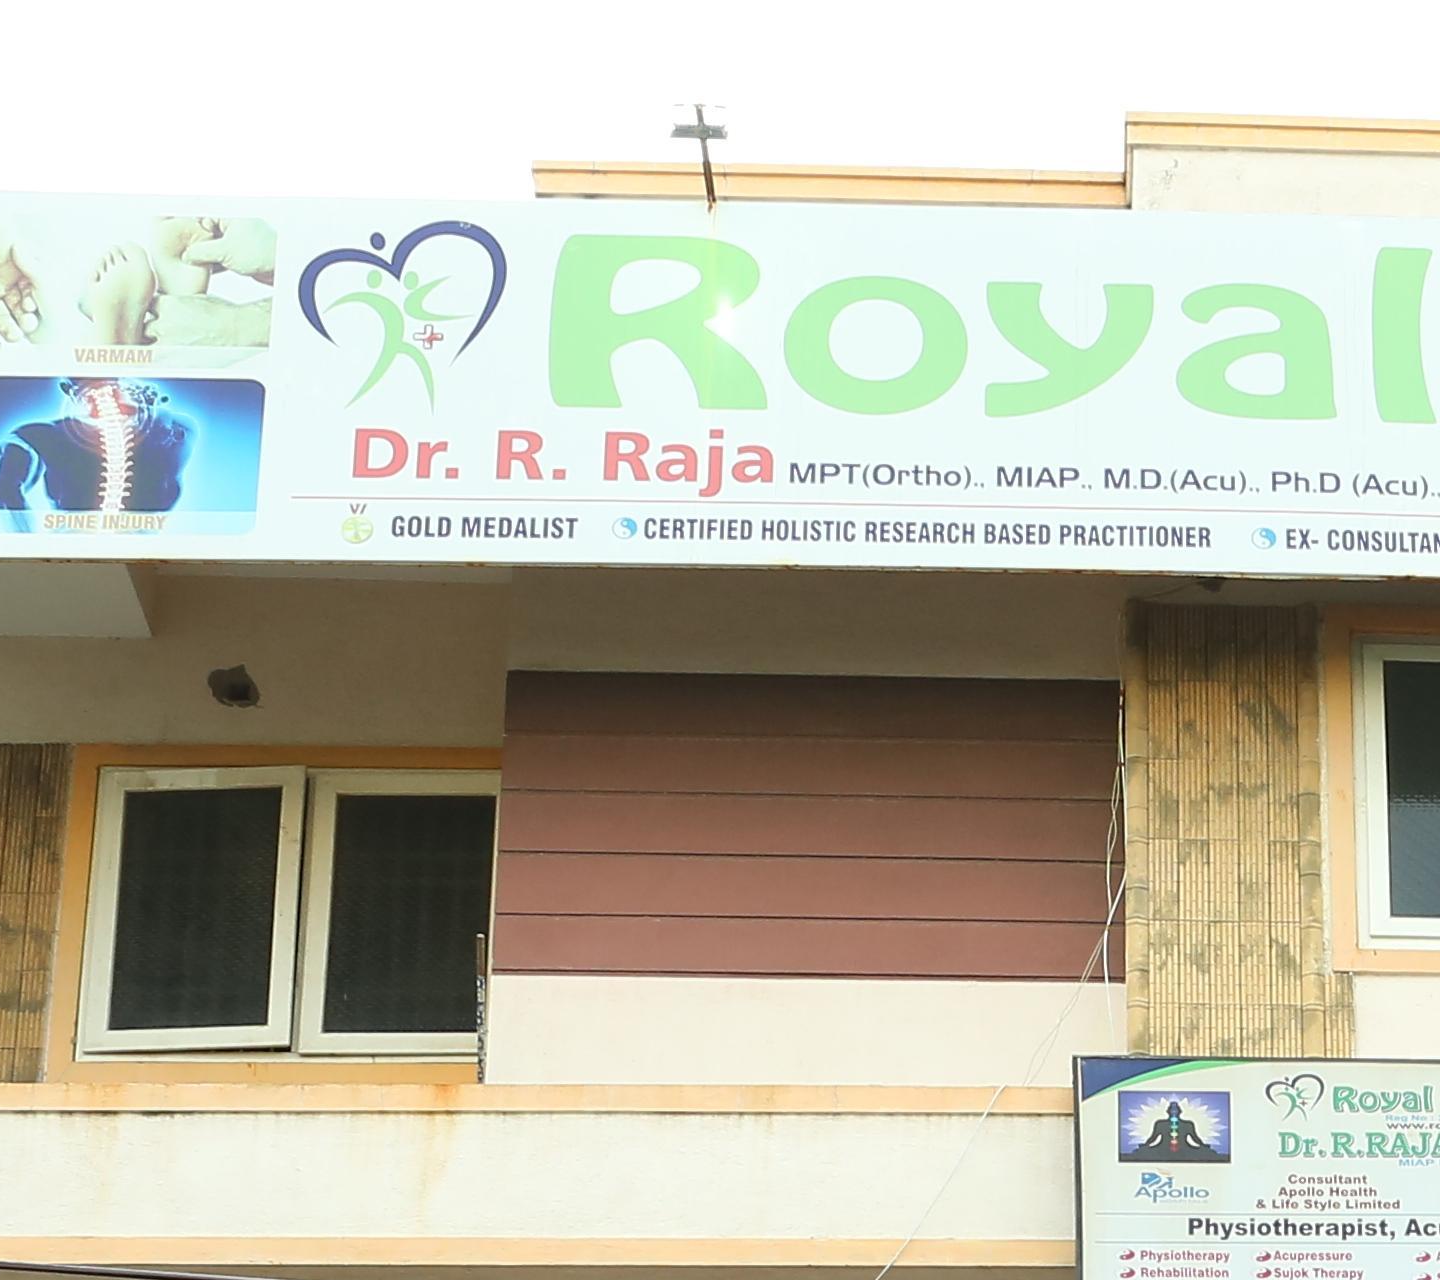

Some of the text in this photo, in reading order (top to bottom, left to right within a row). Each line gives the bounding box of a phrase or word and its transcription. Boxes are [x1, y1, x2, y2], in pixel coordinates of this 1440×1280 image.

[547, 233, 1437, 424] Royal
[74, 348, 152, 363] VARMAM
[352, 428, 774, 498] Dr. R. Raja
[43, 514, 167, 530] SPINE INJURY
[392, 515, 577, 540] GOLD MEDALIST
[644, 518, 1211, 548] CERTIFIED HOLISTIC RESEARCH BASED PRACTITIONER
[1332, 1086, 1433, 1114] Royal
[1188, 1218, 1396, 1240] Physiotherapist,
[1140, 1250, 1230, 1263] Physiotherapy
[1274, 1251, 1352, 1262] Acupressure
[1140, 1268, 1229, 1278] Rehabilitation
[1274, 1268, 1363, 1280] Sujok Therapy
